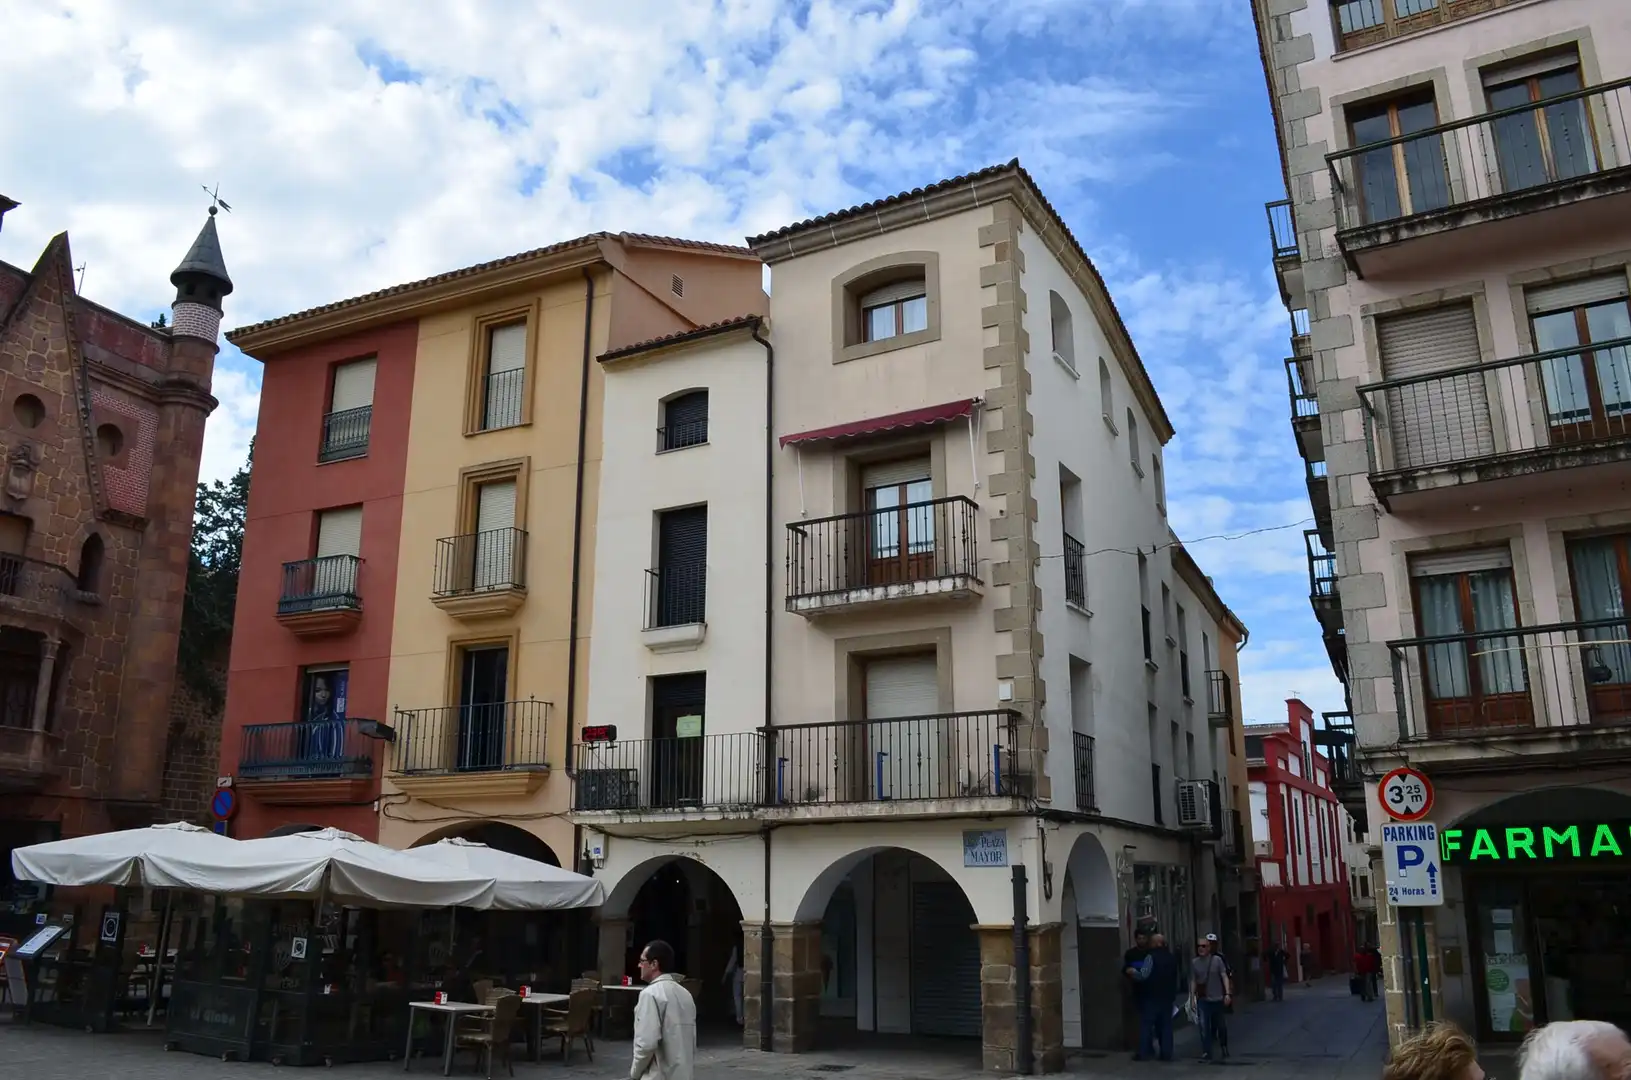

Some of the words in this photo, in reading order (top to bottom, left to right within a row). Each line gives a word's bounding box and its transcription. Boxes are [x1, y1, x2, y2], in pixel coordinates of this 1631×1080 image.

[1411, 794, 1422, 803] m
[1383, 825, 1435, 842] PARKING
[981, 836, 1005, 848] PLAZA
[1441, 824, 1631, 861] FARMA
[971, 850, 1002, 863] MAYOR
[1396, 845, 1425, 878] P
[1389, 887, 1398, 896] 24
[1402, 887, 1425, 896] Horas
